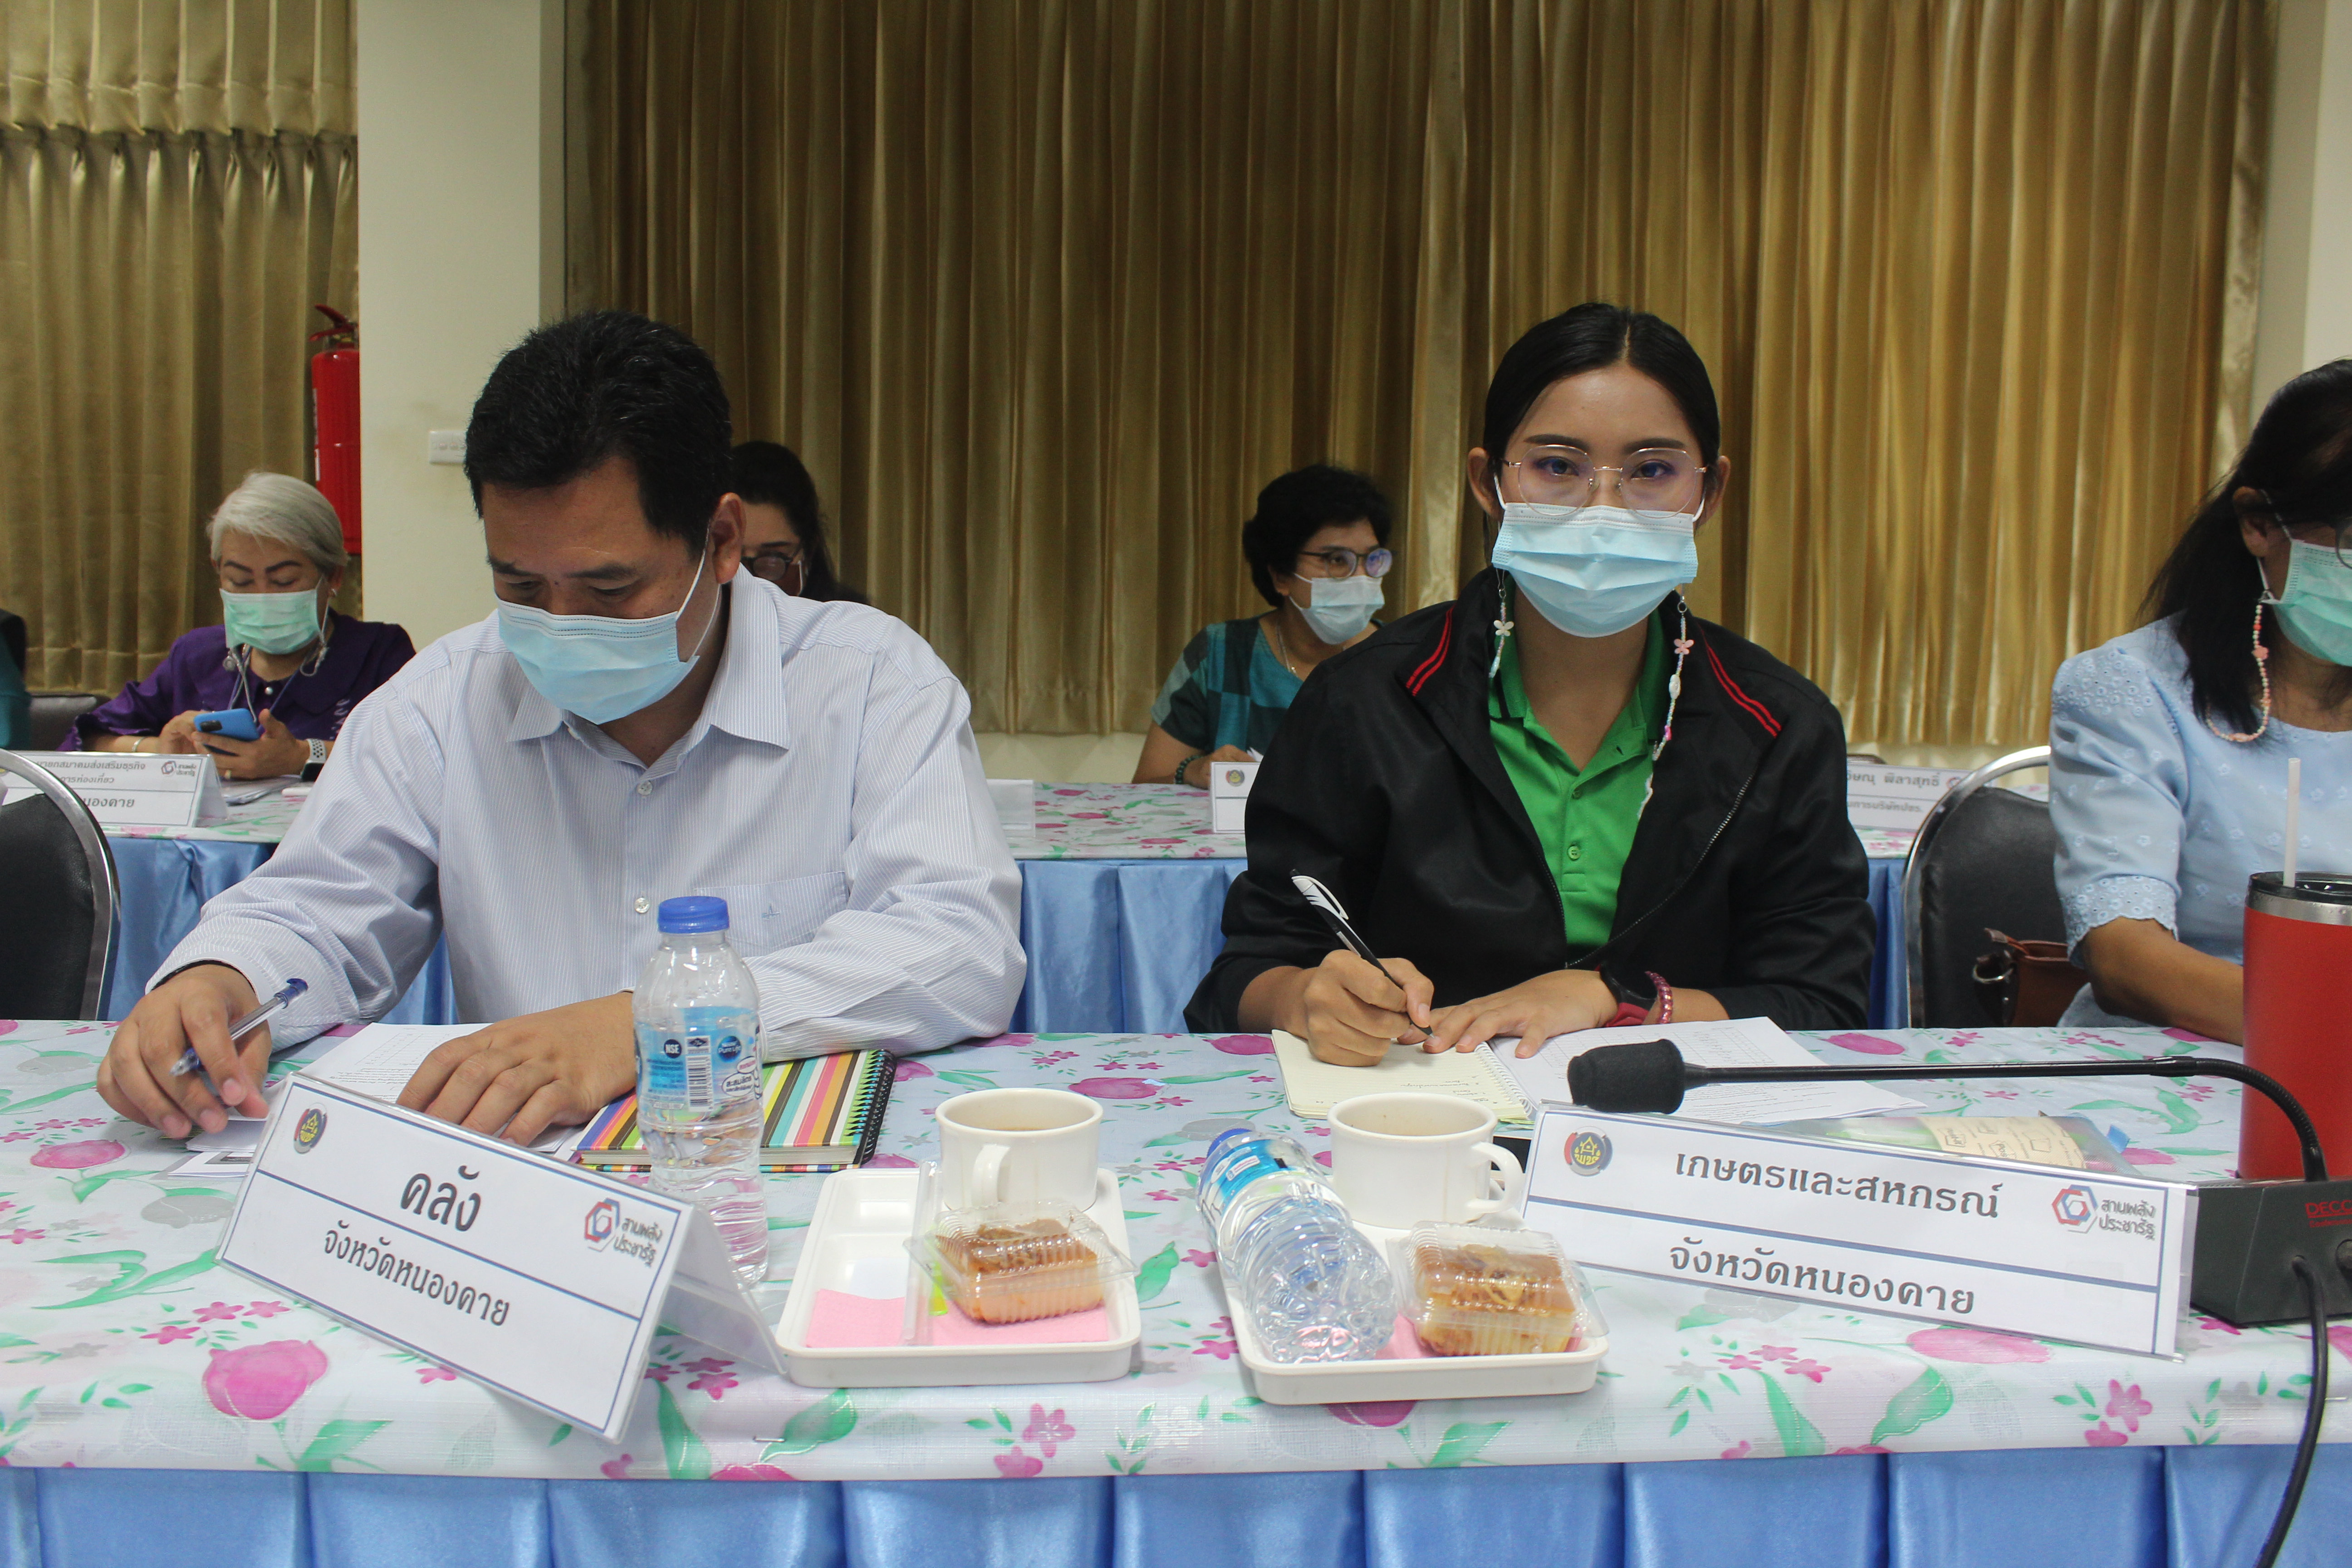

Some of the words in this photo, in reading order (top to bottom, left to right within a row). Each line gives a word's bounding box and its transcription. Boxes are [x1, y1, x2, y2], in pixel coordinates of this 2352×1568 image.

[400, 1165, 481, 1231] คลัง
[1676, 1153, 2003, 1218] เกษตรและสหกรณ์
[2102, 1199, 2155, 1217] สานพลัง
[614, 1234, 656, 1267] ประชารัฐ
[621, 1218, 663, 1243] สานพลัง
[2099, 1214, 2155, 1240] ประชารัฐ
[324, 1220, 510, 1326] จังหวัดหนองคาย
[1670, 1237, 1974, 1314] จังหวัดหนองคาย
